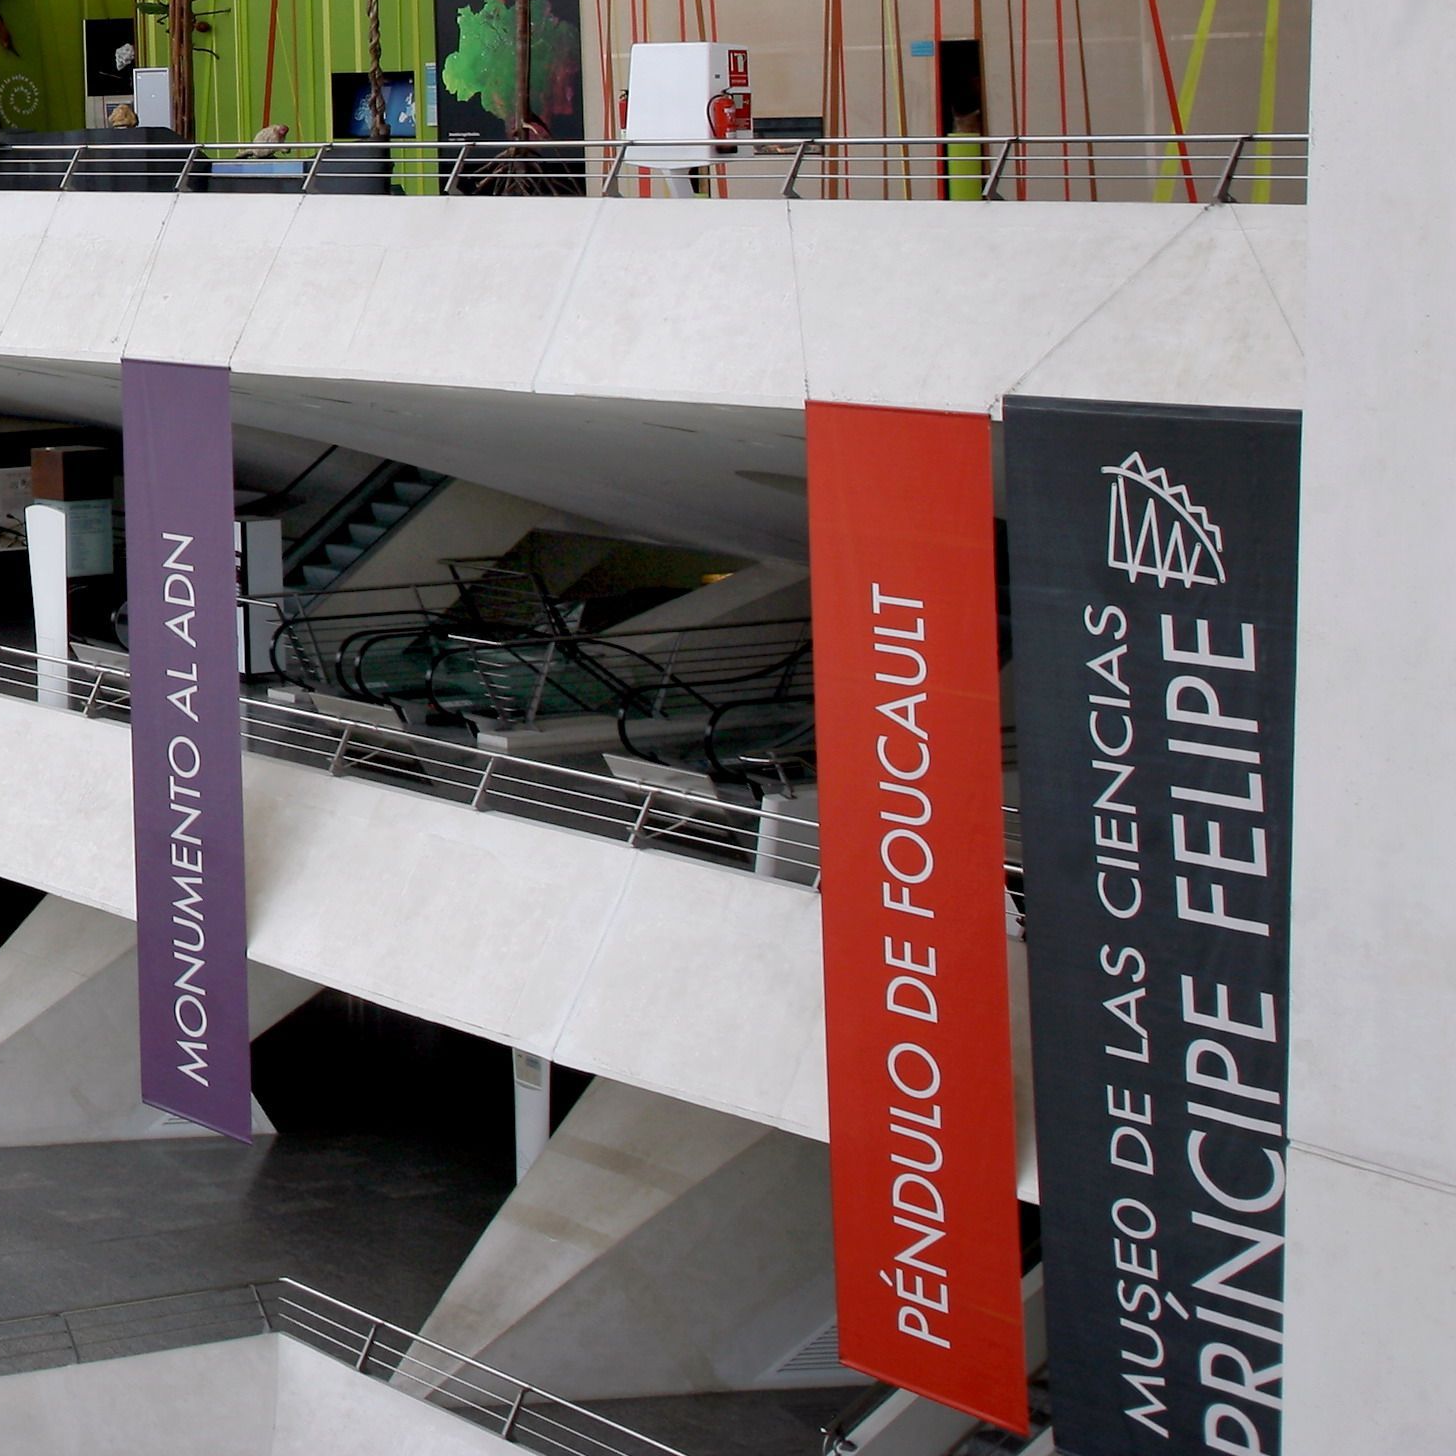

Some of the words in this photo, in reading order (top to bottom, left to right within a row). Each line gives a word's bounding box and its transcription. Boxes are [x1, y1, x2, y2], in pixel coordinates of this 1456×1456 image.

[161, 531, 197, 647] ADN
[168, 661, 199, 723] AL
[871, 582, 935, 920] FOUCAULT
[1083, 604, 1145, 920] CIENCIAS
[1160, 613, 1271, 937] FELIPE
[168, 737, 210, 1088] MONUMENTO
[883, 936, 938, 1025] DE
[1100, 943, 1150, 1064] LAS
[879, 1040, 950, 1350] PÉNDULO
[1106, 1084, 1155, 1176] DE
[1111, 1197, 1170, 1440] MUSEO
